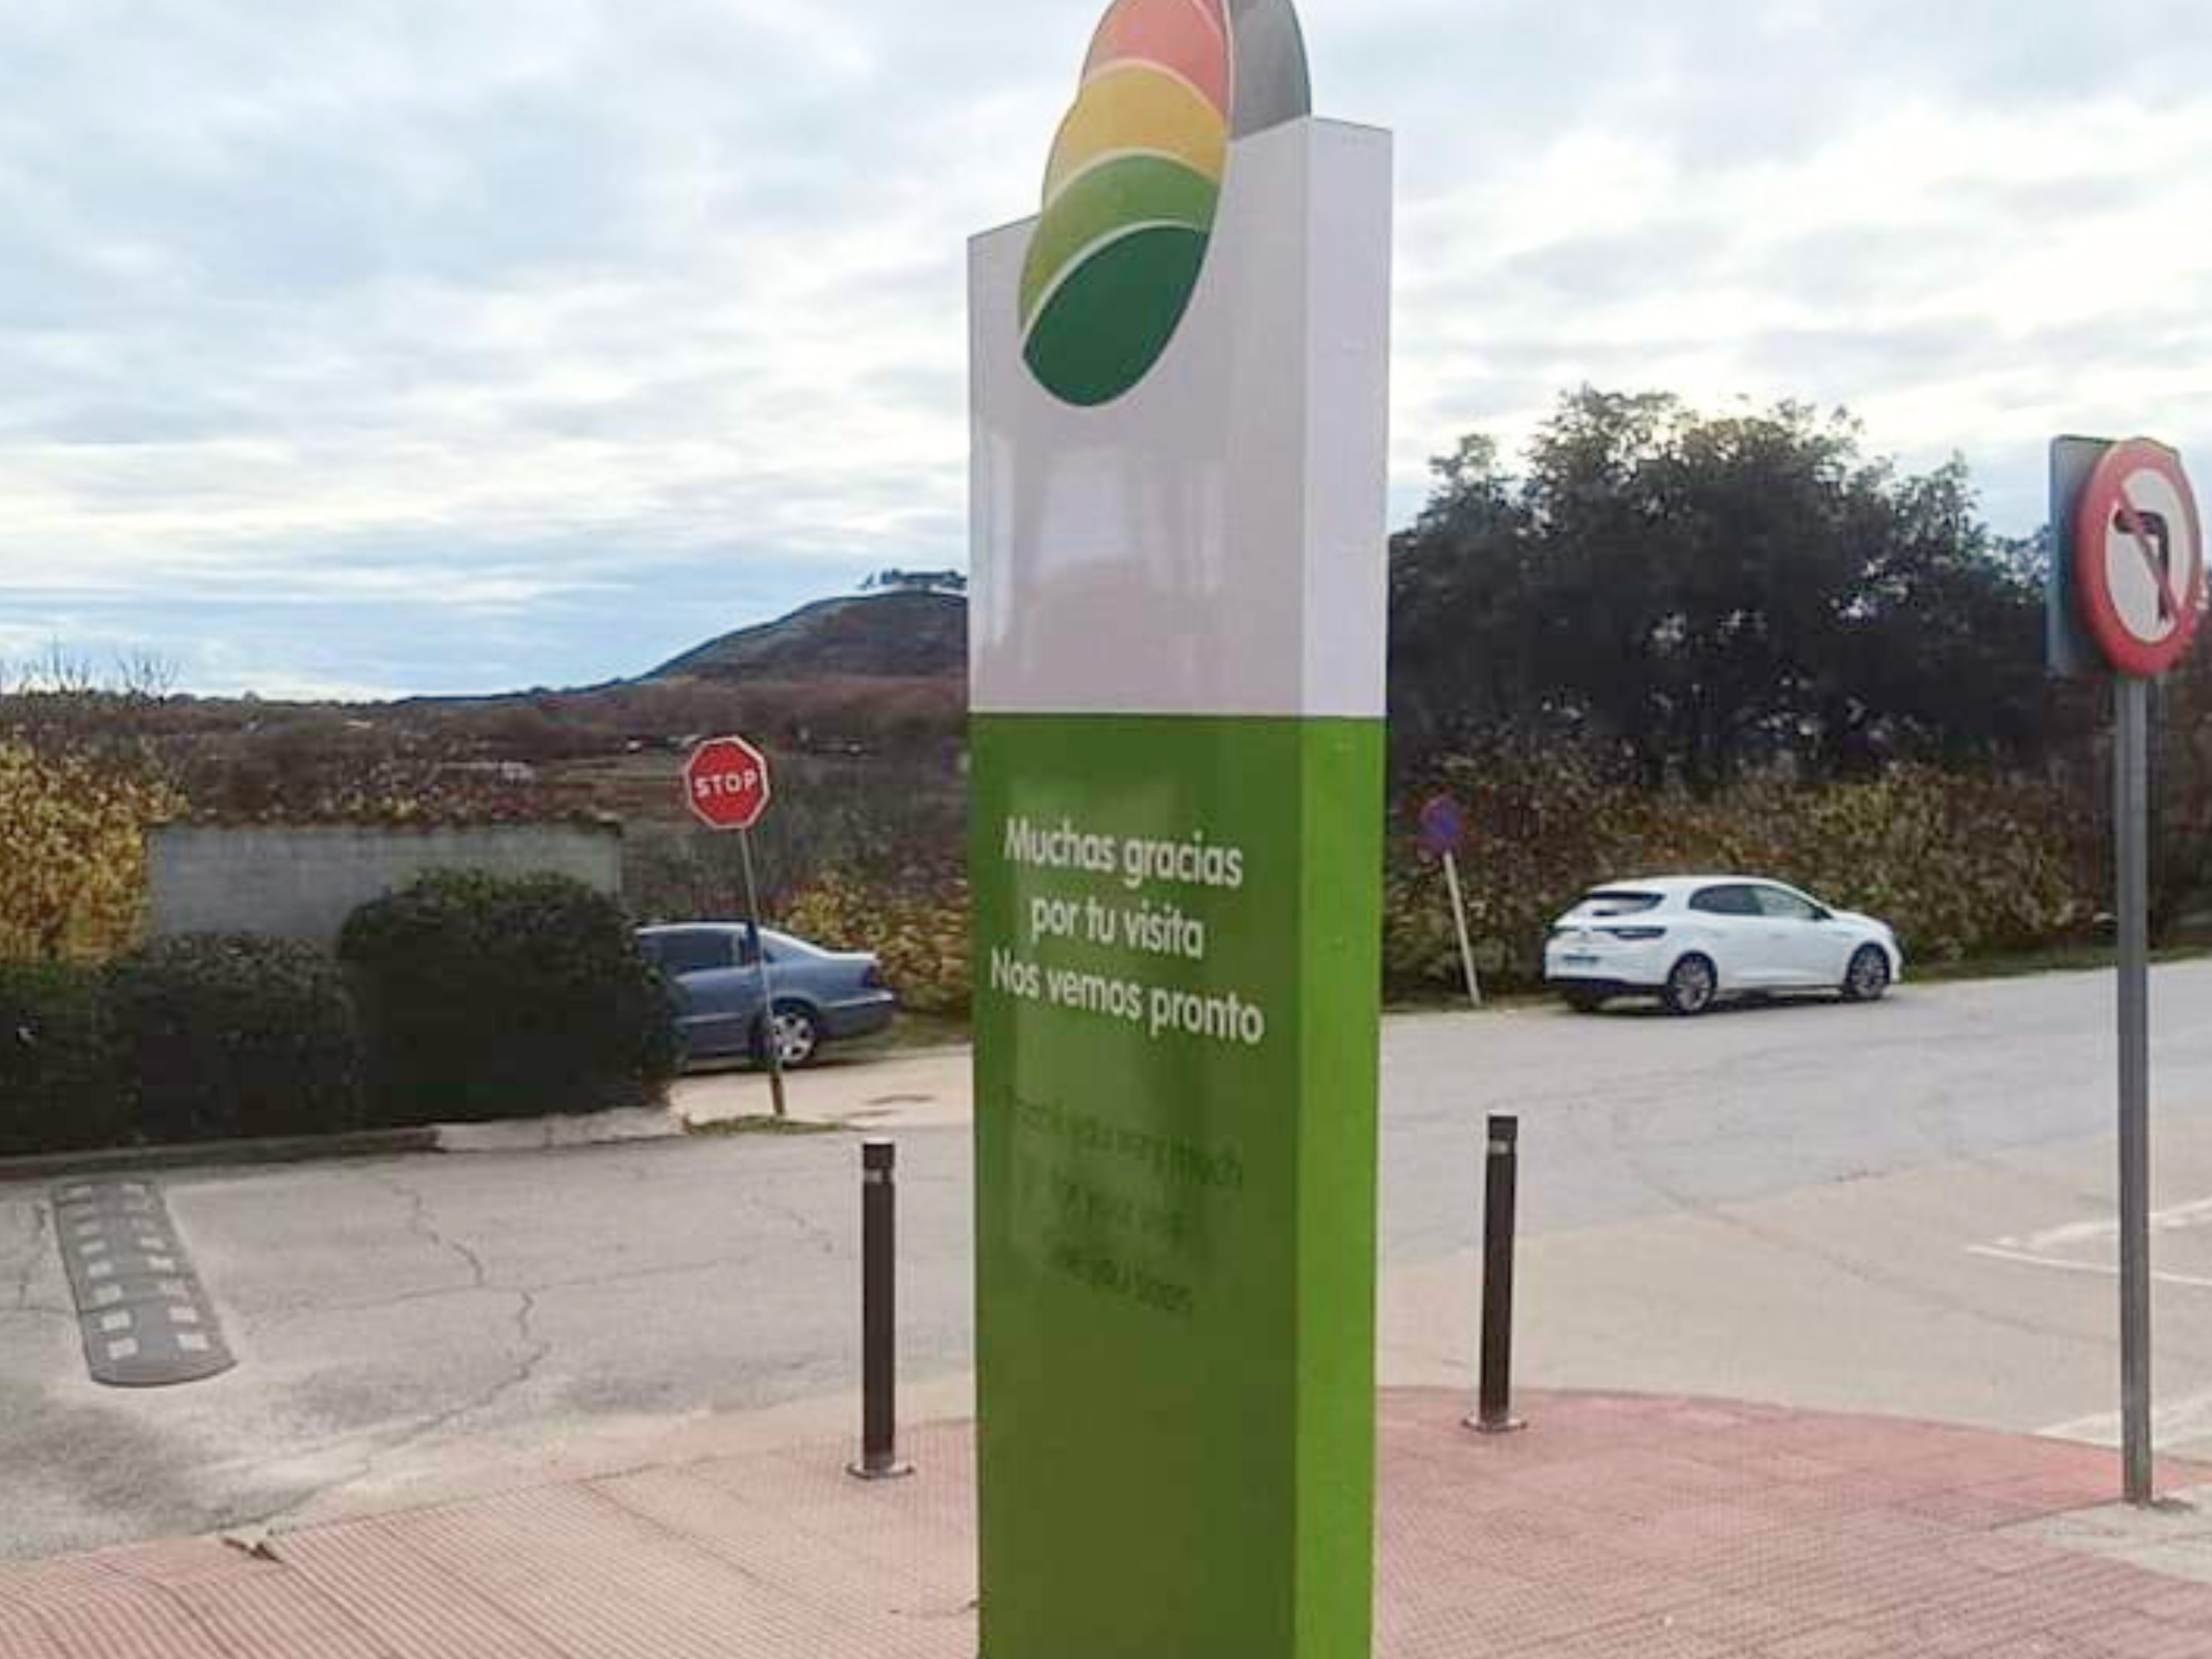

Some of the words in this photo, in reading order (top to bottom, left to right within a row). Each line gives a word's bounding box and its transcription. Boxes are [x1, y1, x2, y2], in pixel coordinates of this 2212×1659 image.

[695, 769, 758, 798] STOP
[1004, 816, 1117, 872] Muchas
[1124, 831, 1243, 888] gracias
[1032, 895, 1078, 944] por
[1087, 895, 1116, 944] tu
[1123, 899, 1204, 959] visita
[992, 947, 1040, 998] Nos
[1047, 968, 1142, 1020] vemos
[1151, 987, 1265, 1044] pronto
